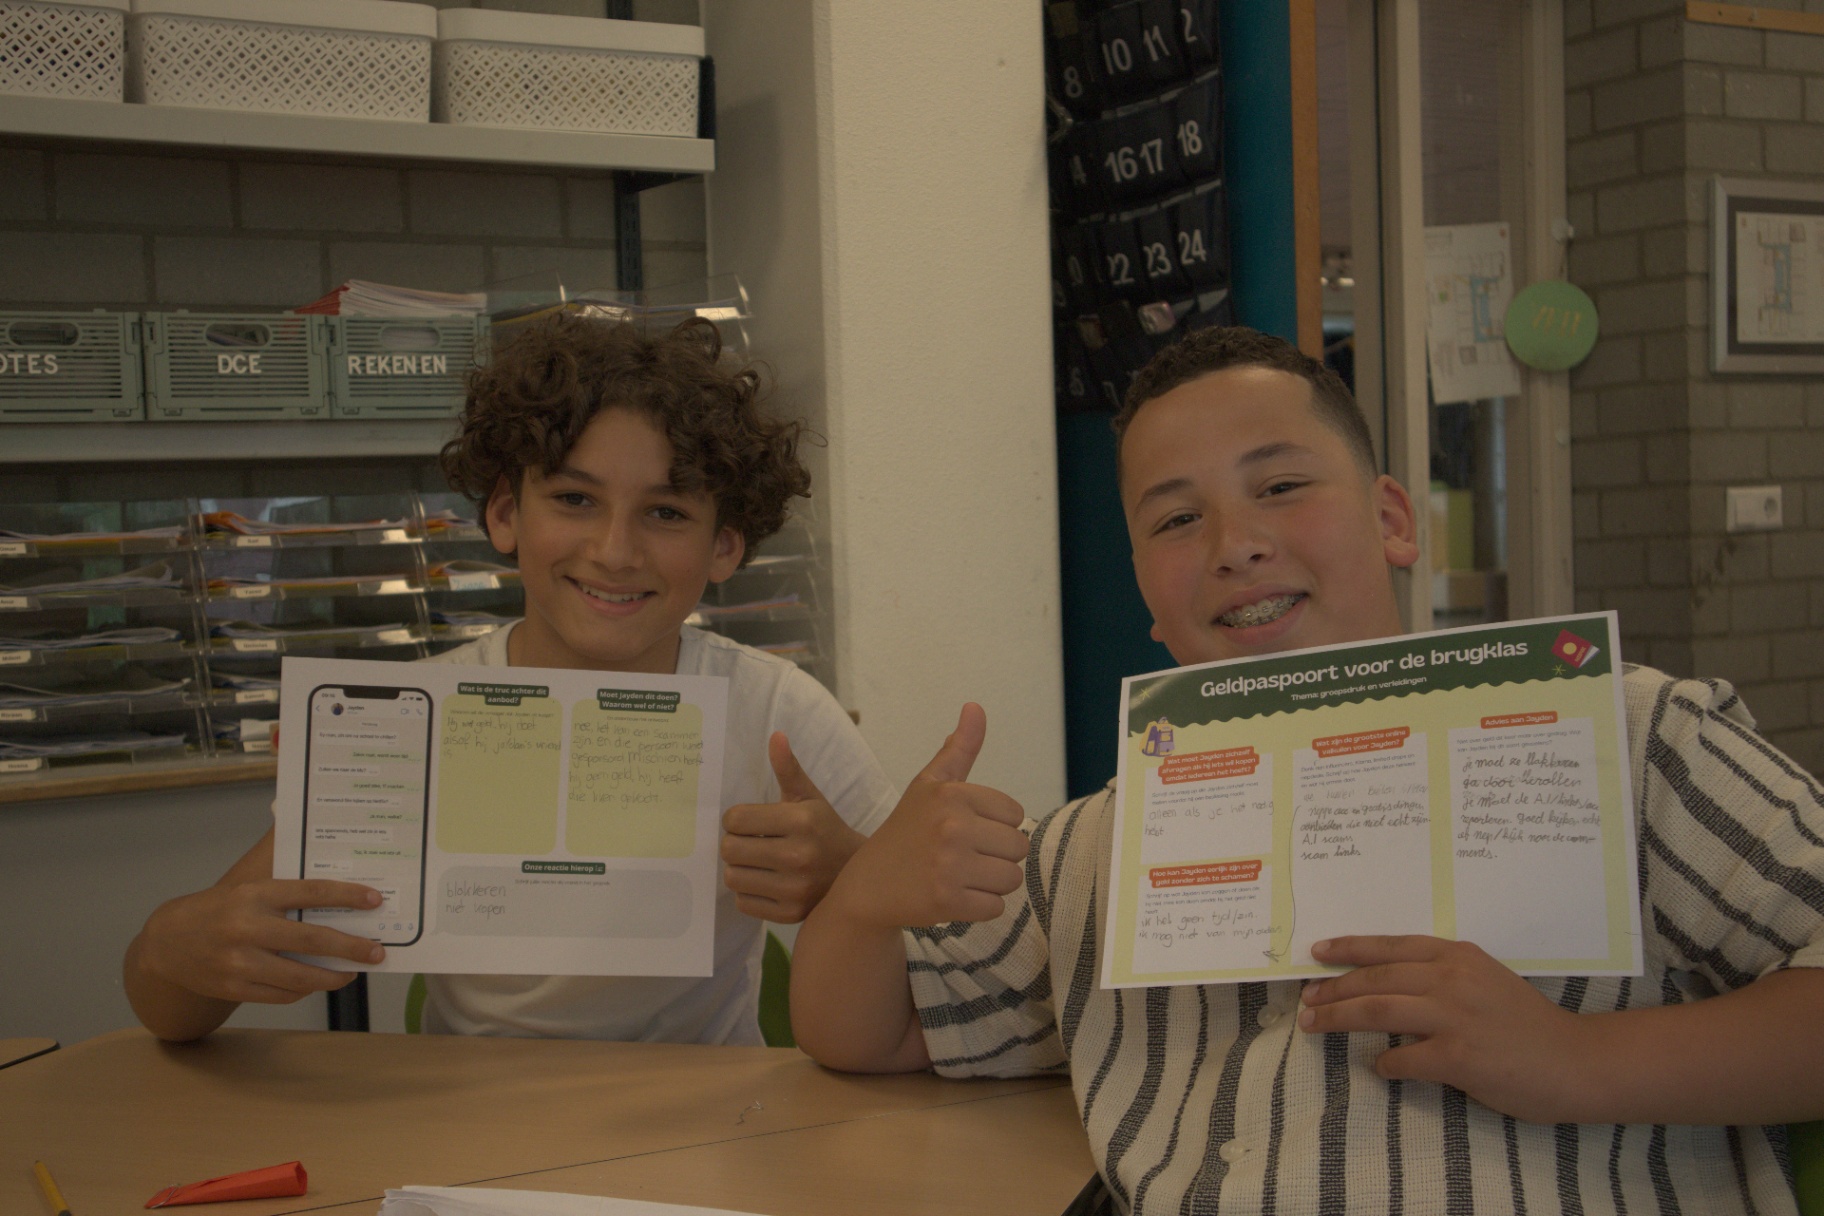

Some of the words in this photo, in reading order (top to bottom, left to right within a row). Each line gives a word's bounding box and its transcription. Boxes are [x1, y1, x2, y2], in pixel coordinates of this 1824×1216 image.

[1102, 38, 1132, 75] 10
[1143, 25, 1170, 62] 11
[1181, 9, 1198, 43] 2
[1105, 146, 1139, 184] 16
[1140, 138, 1163, 175] 17
[1177, 120, 1202, 157] 18
[1143, 242, 1172, 278] 23
[1179, 229, 1207, 266] 24
[217, 354, 262, 374] DCE
[348, 355, 447, 375] REKENEN
[1200, 664, 1339, 698] Geldpaspoort
[1344, 656, 1395, 678] voor
[1399, 652, 1426, 671] de
[1430, 641, 1529, 666] brugklas
[511, 687, 534, 695] achter
[1291, 691, 1319, 701] Thema:
[1320, 683, 1366, 699] groepsdruk
[1367, 683, 1378, 691] en
[1379, 675, 1427, 690] verleidingen
[646, 692, 656, 700] dit
[656, 693, 678, 701] doen?
[602, 701, 632, 709] Waarom
[1485, 718, 1509, 726] Advies
[1526, 715, 1554, 723] Jayden
[1353, 733, 1384, 743] grootste
[1385, 730, 1406, 738] online
[1370, 739, 1400, 749] Jayden?
[1200, 753, 1224, 761] Jayden
[1225, 749, 1250, 757] zichzelf
[1162, 766, 1192, 774] afvragen
[1236, 758, 1256, 766] kopen
[1463, 756, 1473, 772] je
[1475, 755, 1504, 768] moet
[1188, 771, 1216, 779] iedereen
[1514, 792, 1529, 804] de
[1185, 806, 1200, 817] als
[1346, 820, 1360, 829] die
[1364, 814, 1386, 827] niet
[1387, 813, 1410, 827] echt
[1517, 812, 1544, 825] goed
[1301, 851, 1329, 860] scam
[1334, 844, 1361, 856] links
[524, 863, 542, 872] Onze
[544, 864, 569, 872] reactie
[570, 865, 594, 873] hierop
[1207, 866, 1228, 874] eerlijk
[1221, 872, 1254, 880] schamen?
[446, 881, 506, 898] blokkeren
[1179, 928, 1198, 939] niet
[1206, 930, 1225, 938] van
